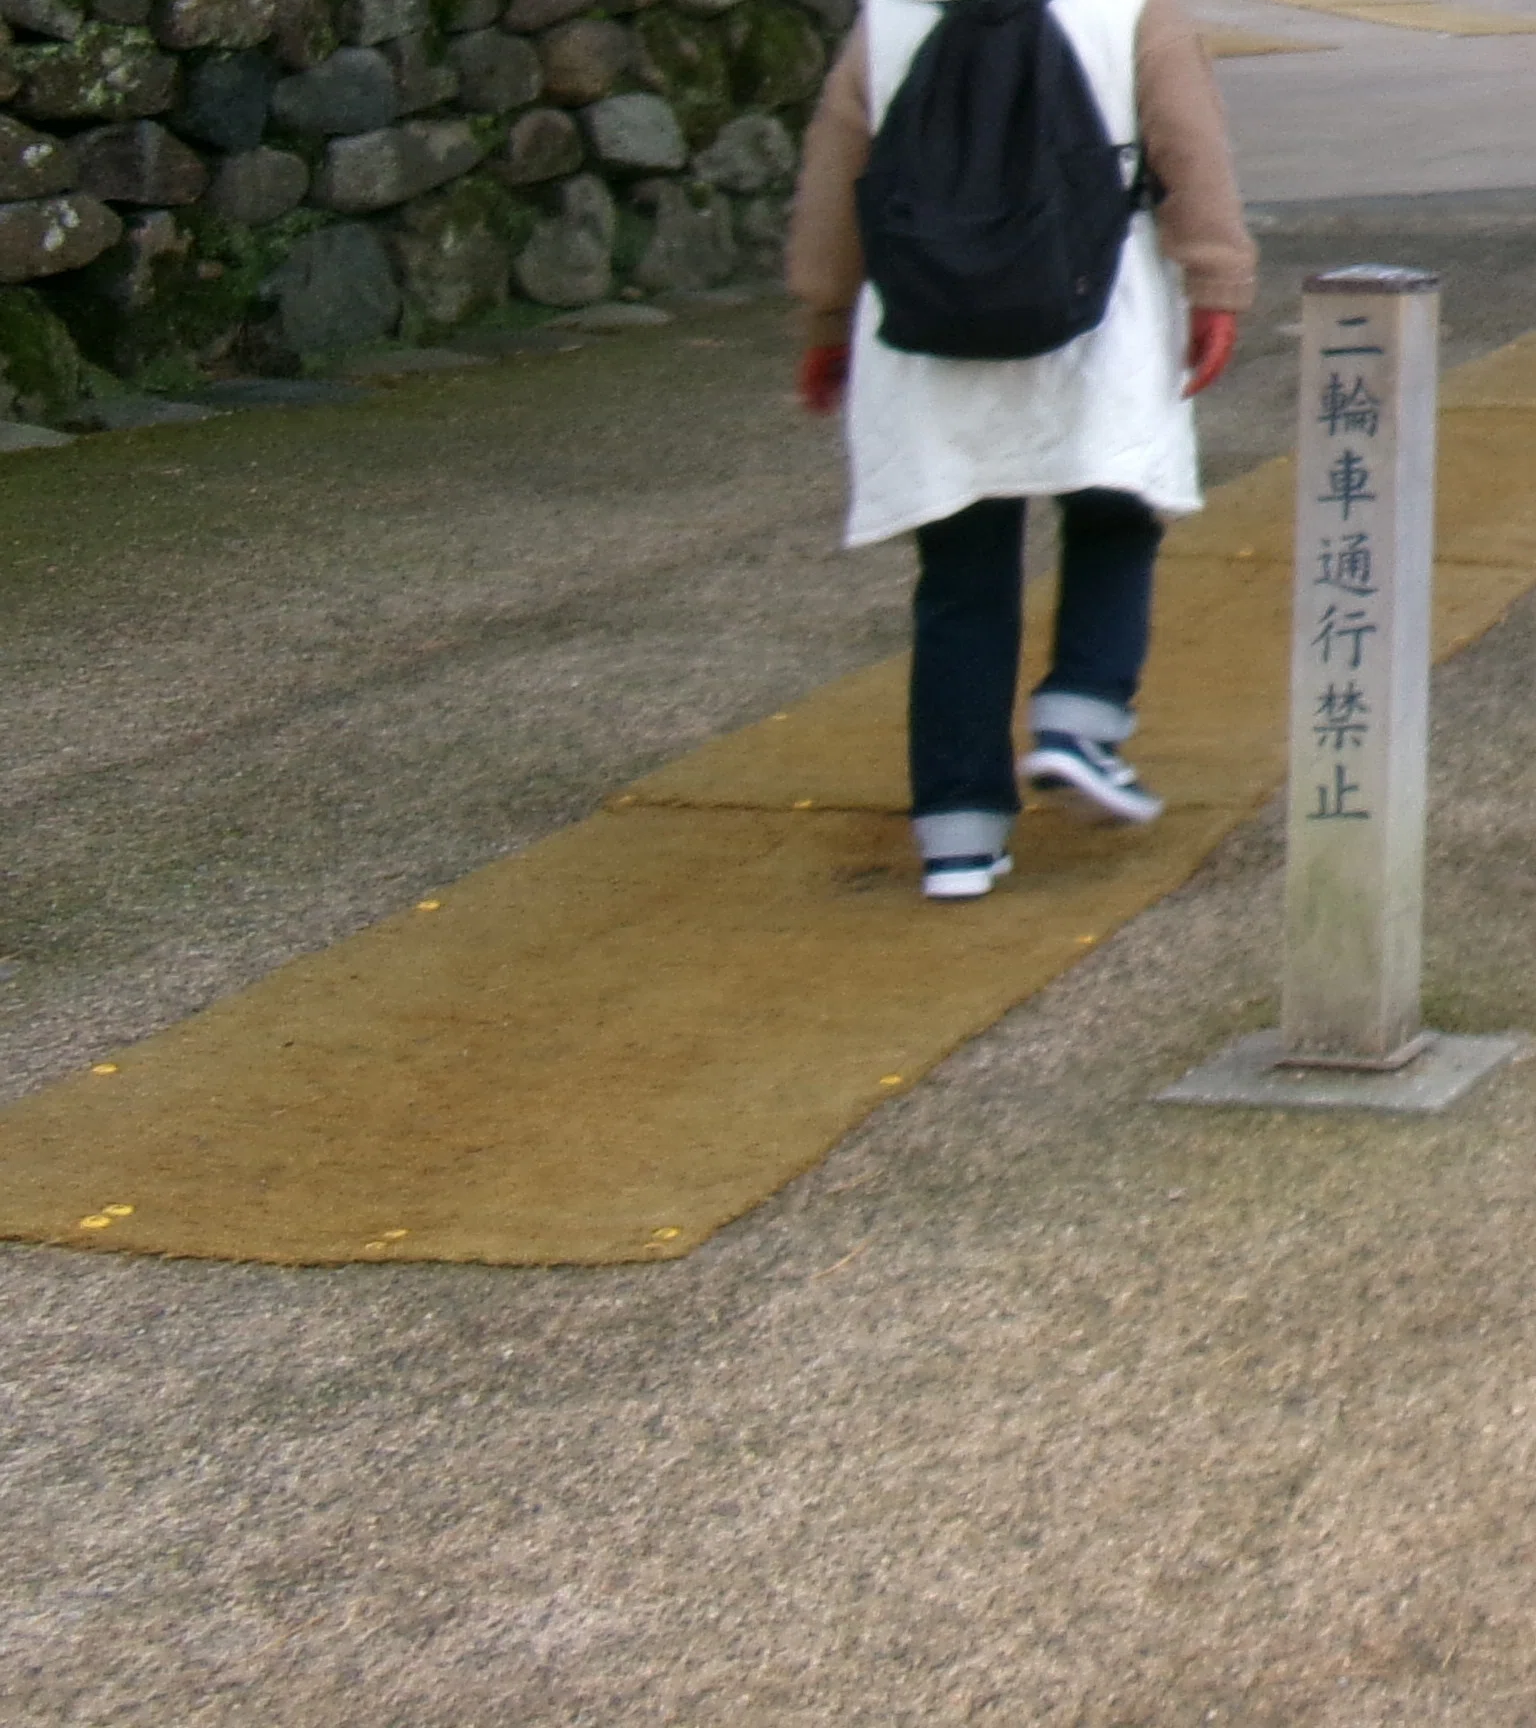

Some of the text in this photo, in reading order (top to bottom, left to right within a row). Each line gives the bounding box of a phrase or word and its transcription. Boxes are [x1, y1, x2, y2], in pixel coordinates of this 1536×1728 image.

[1305, 314, 1384, 823] 二輪車通行禁止
